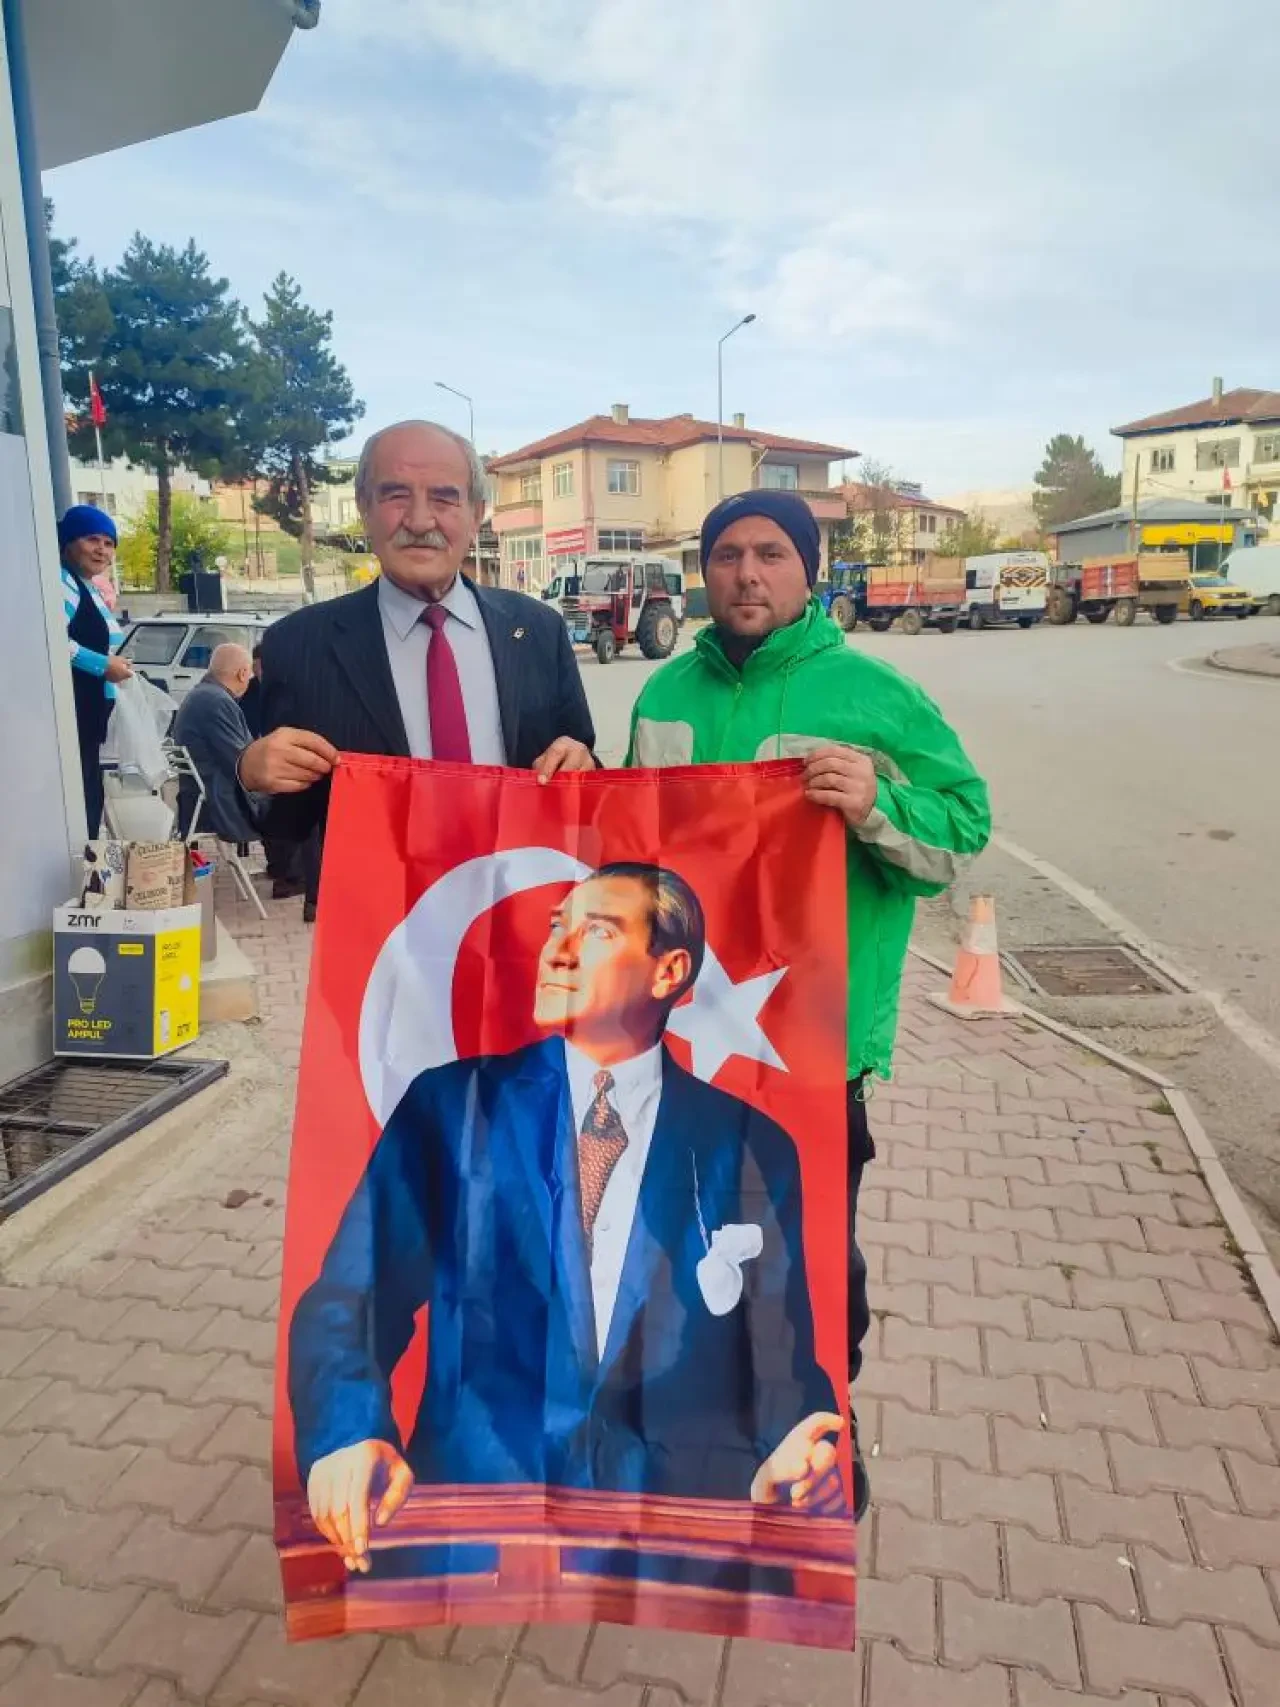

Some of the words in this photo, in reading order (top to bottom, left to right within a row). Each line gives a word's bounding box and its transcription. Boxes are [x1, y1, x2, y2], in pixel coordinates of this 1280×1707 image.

[67, 914, 102, 928] zmr
[67, 1018, 88, 1029] PRO
[91, 1019, 112, 1030] LED
[67, 1030, 104, 1039] AMPUL
